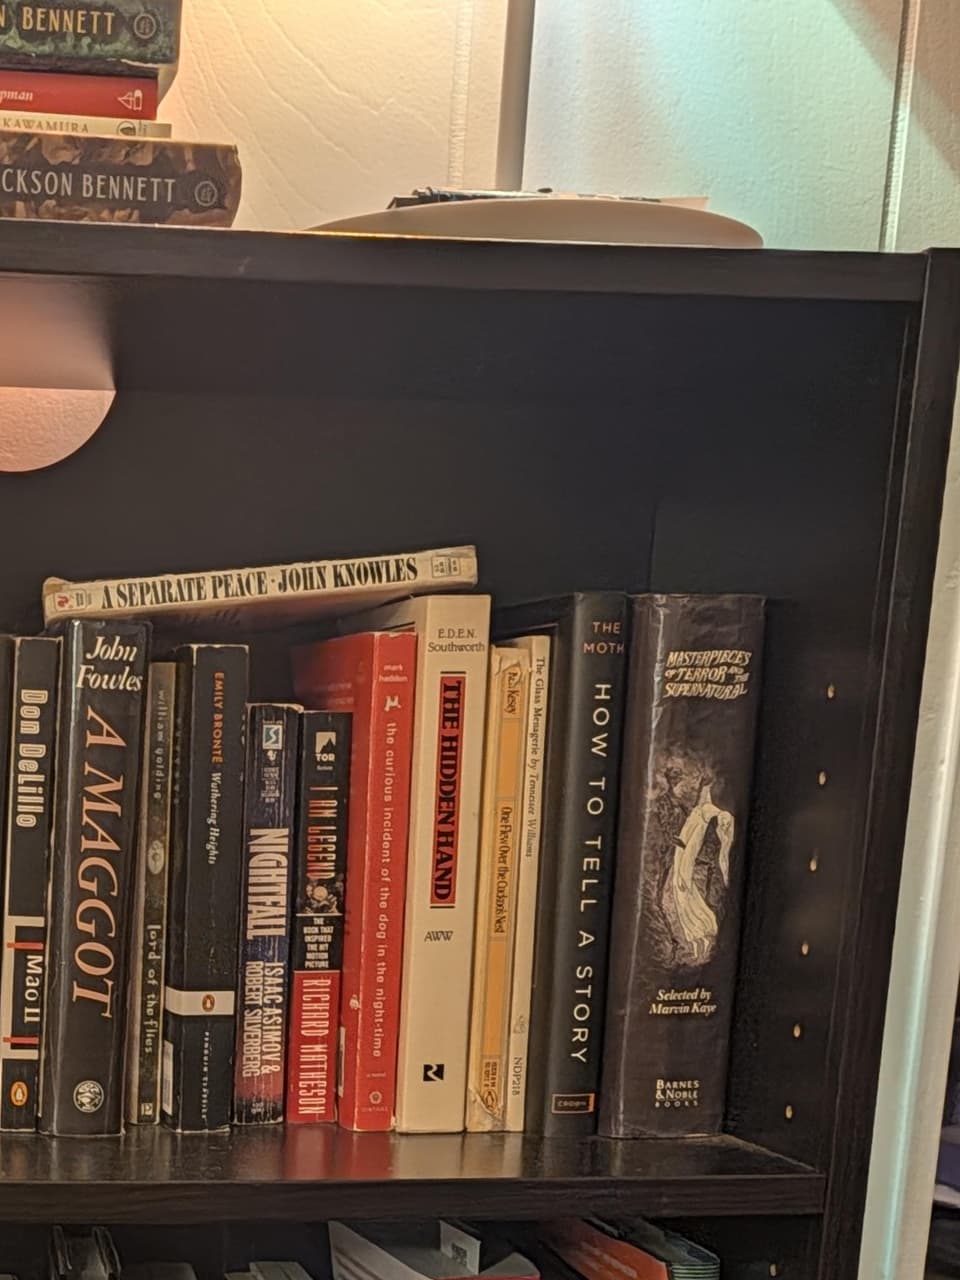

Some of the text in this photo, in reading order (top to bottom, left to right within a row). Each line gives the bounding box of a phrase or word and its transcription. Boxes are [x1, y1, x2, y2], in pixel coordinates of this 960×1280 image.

[22, 8, 115, 36] BENNETT
[82, 171, 175, 204] BENNETT
[100, 556, 419, 609] A SEPARATE PEACE JOHN KNOWLES
[15, 689, 48, 827] Don DeLillo
[433, 683, 463, 902] THE HIDDEN HAND
[72, 705, 127, 1018] A MAGGOT
[246, 827, 289, 941] NIGHTFALL
[570, 684, 612, 1064] HOW TO TELL A STORY
[24, 953, 45, 1023] Mao II
[298, 978, 335, 1114] RICHARD MATHESON
